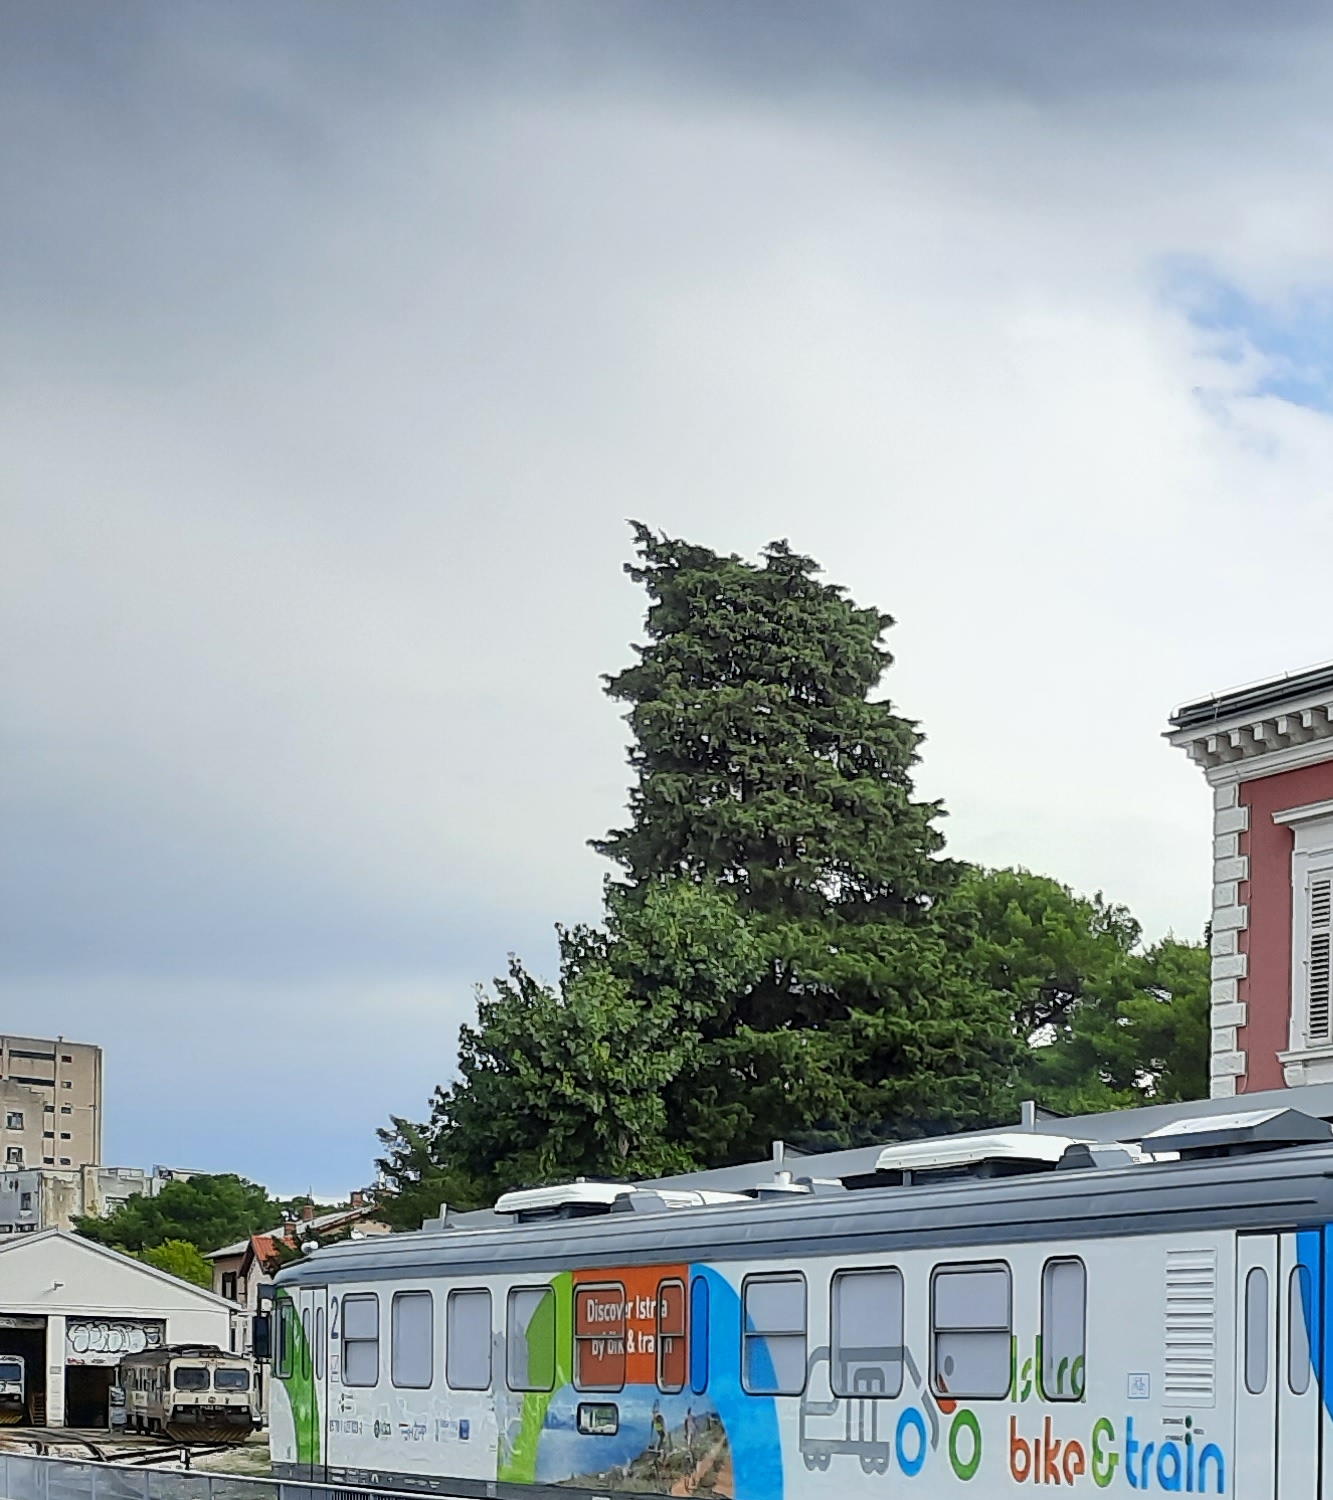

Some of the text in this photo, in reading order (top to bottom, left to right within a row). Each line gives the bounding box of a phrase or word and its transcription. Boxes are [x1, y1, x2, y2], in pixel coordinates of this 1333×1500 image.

[330, 1296, 339, 1339] 2
[635, 1295, 668, 1319] Istra
[626, 1329, 636, 1353] &
[638, 1331, 673, 1354] tran
